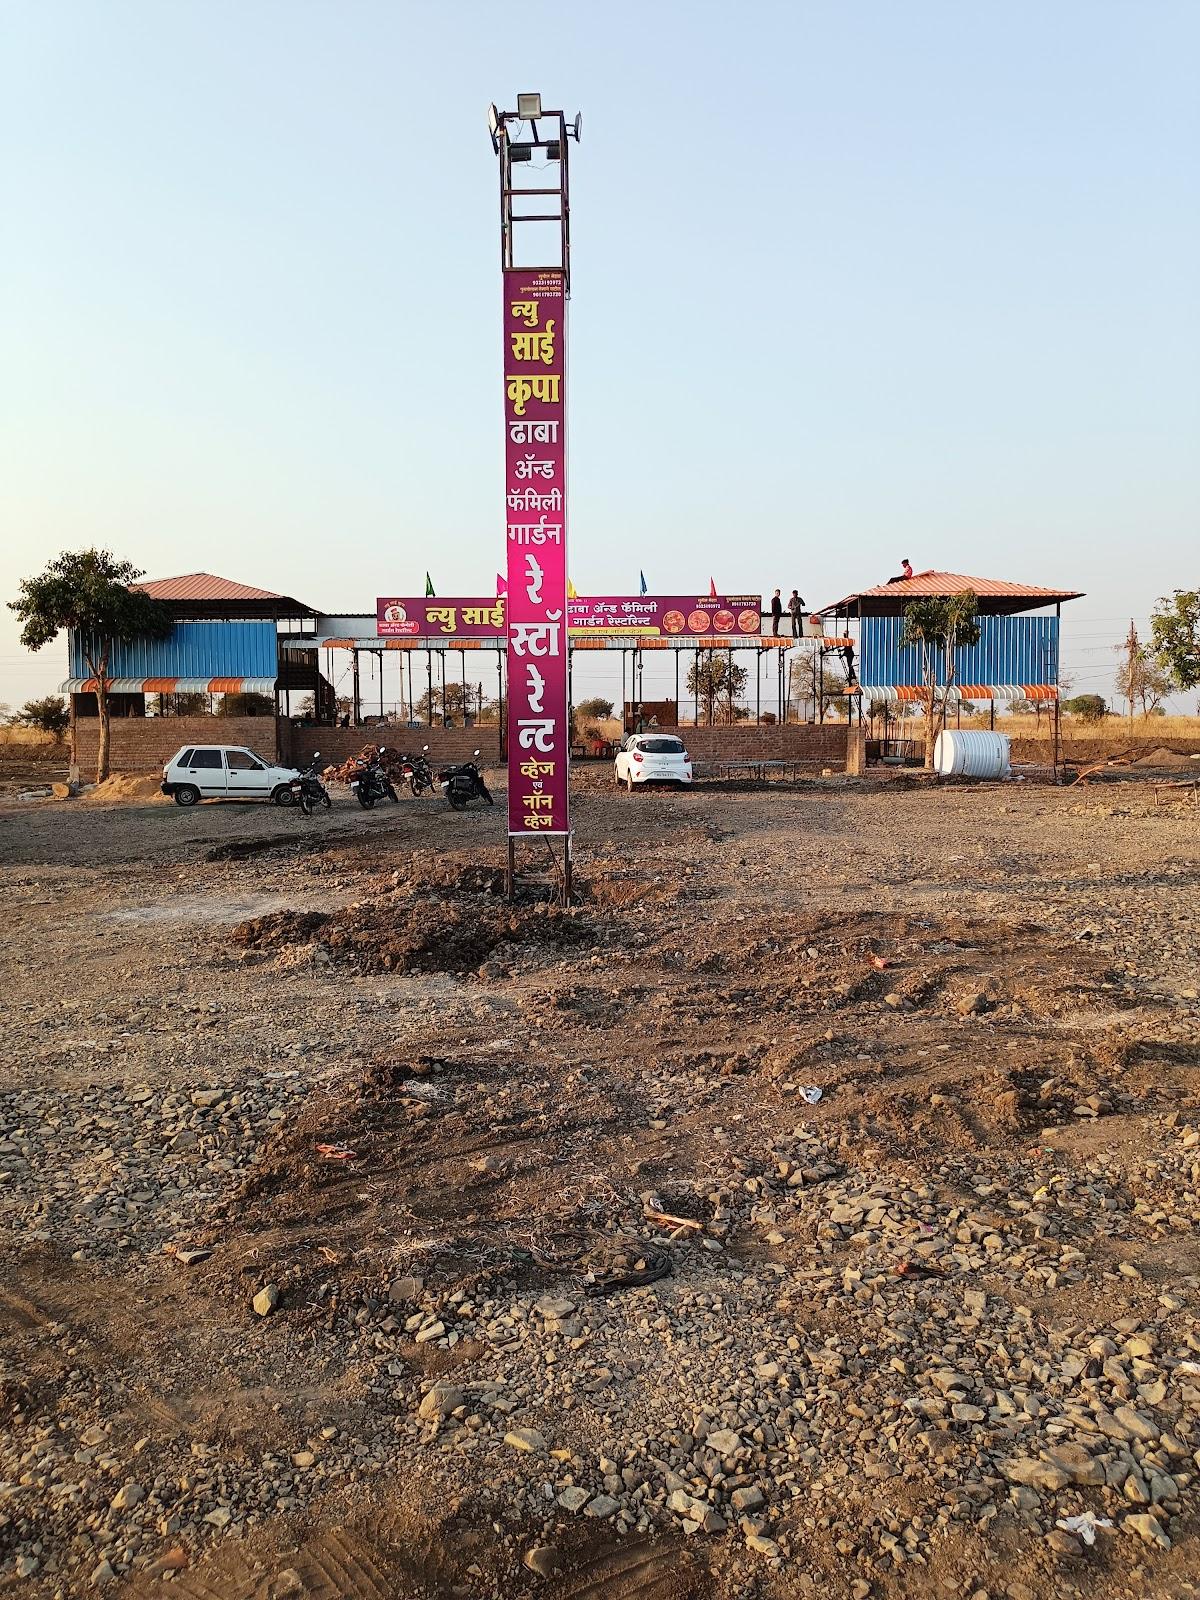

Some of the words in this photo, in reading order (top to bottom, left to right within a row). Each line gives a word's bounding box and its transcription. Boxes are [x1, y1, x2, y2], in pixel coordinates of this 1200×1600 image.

[511, 301, 539, 327] न्यु
[511, 320, 555, 365] साई
[506, 375, 560, 415] कृपा
[509, 421, 559, 444] ढाबा
[507, 487, 562, 512] फॅमिली
[507, 515, 562, 545] गार्डन
[525, 553, 544, 604] रे
[425, 607, 457, 633] न्यु
[461, 599, 505, 628] साई
[573, 615, 604, 626] गार्डन
[621, 601, 658, 613] फॅमिली
[510, 608, 563, 656] स्टॉ
[526, 663, 545, 713] रे
[518, 719, 555, 752] न्ट
[520, 756, 555, 779] व्हेज
[522, 790, 553, 809] नॉन
[523, 810, 553, 829] व्हेज
